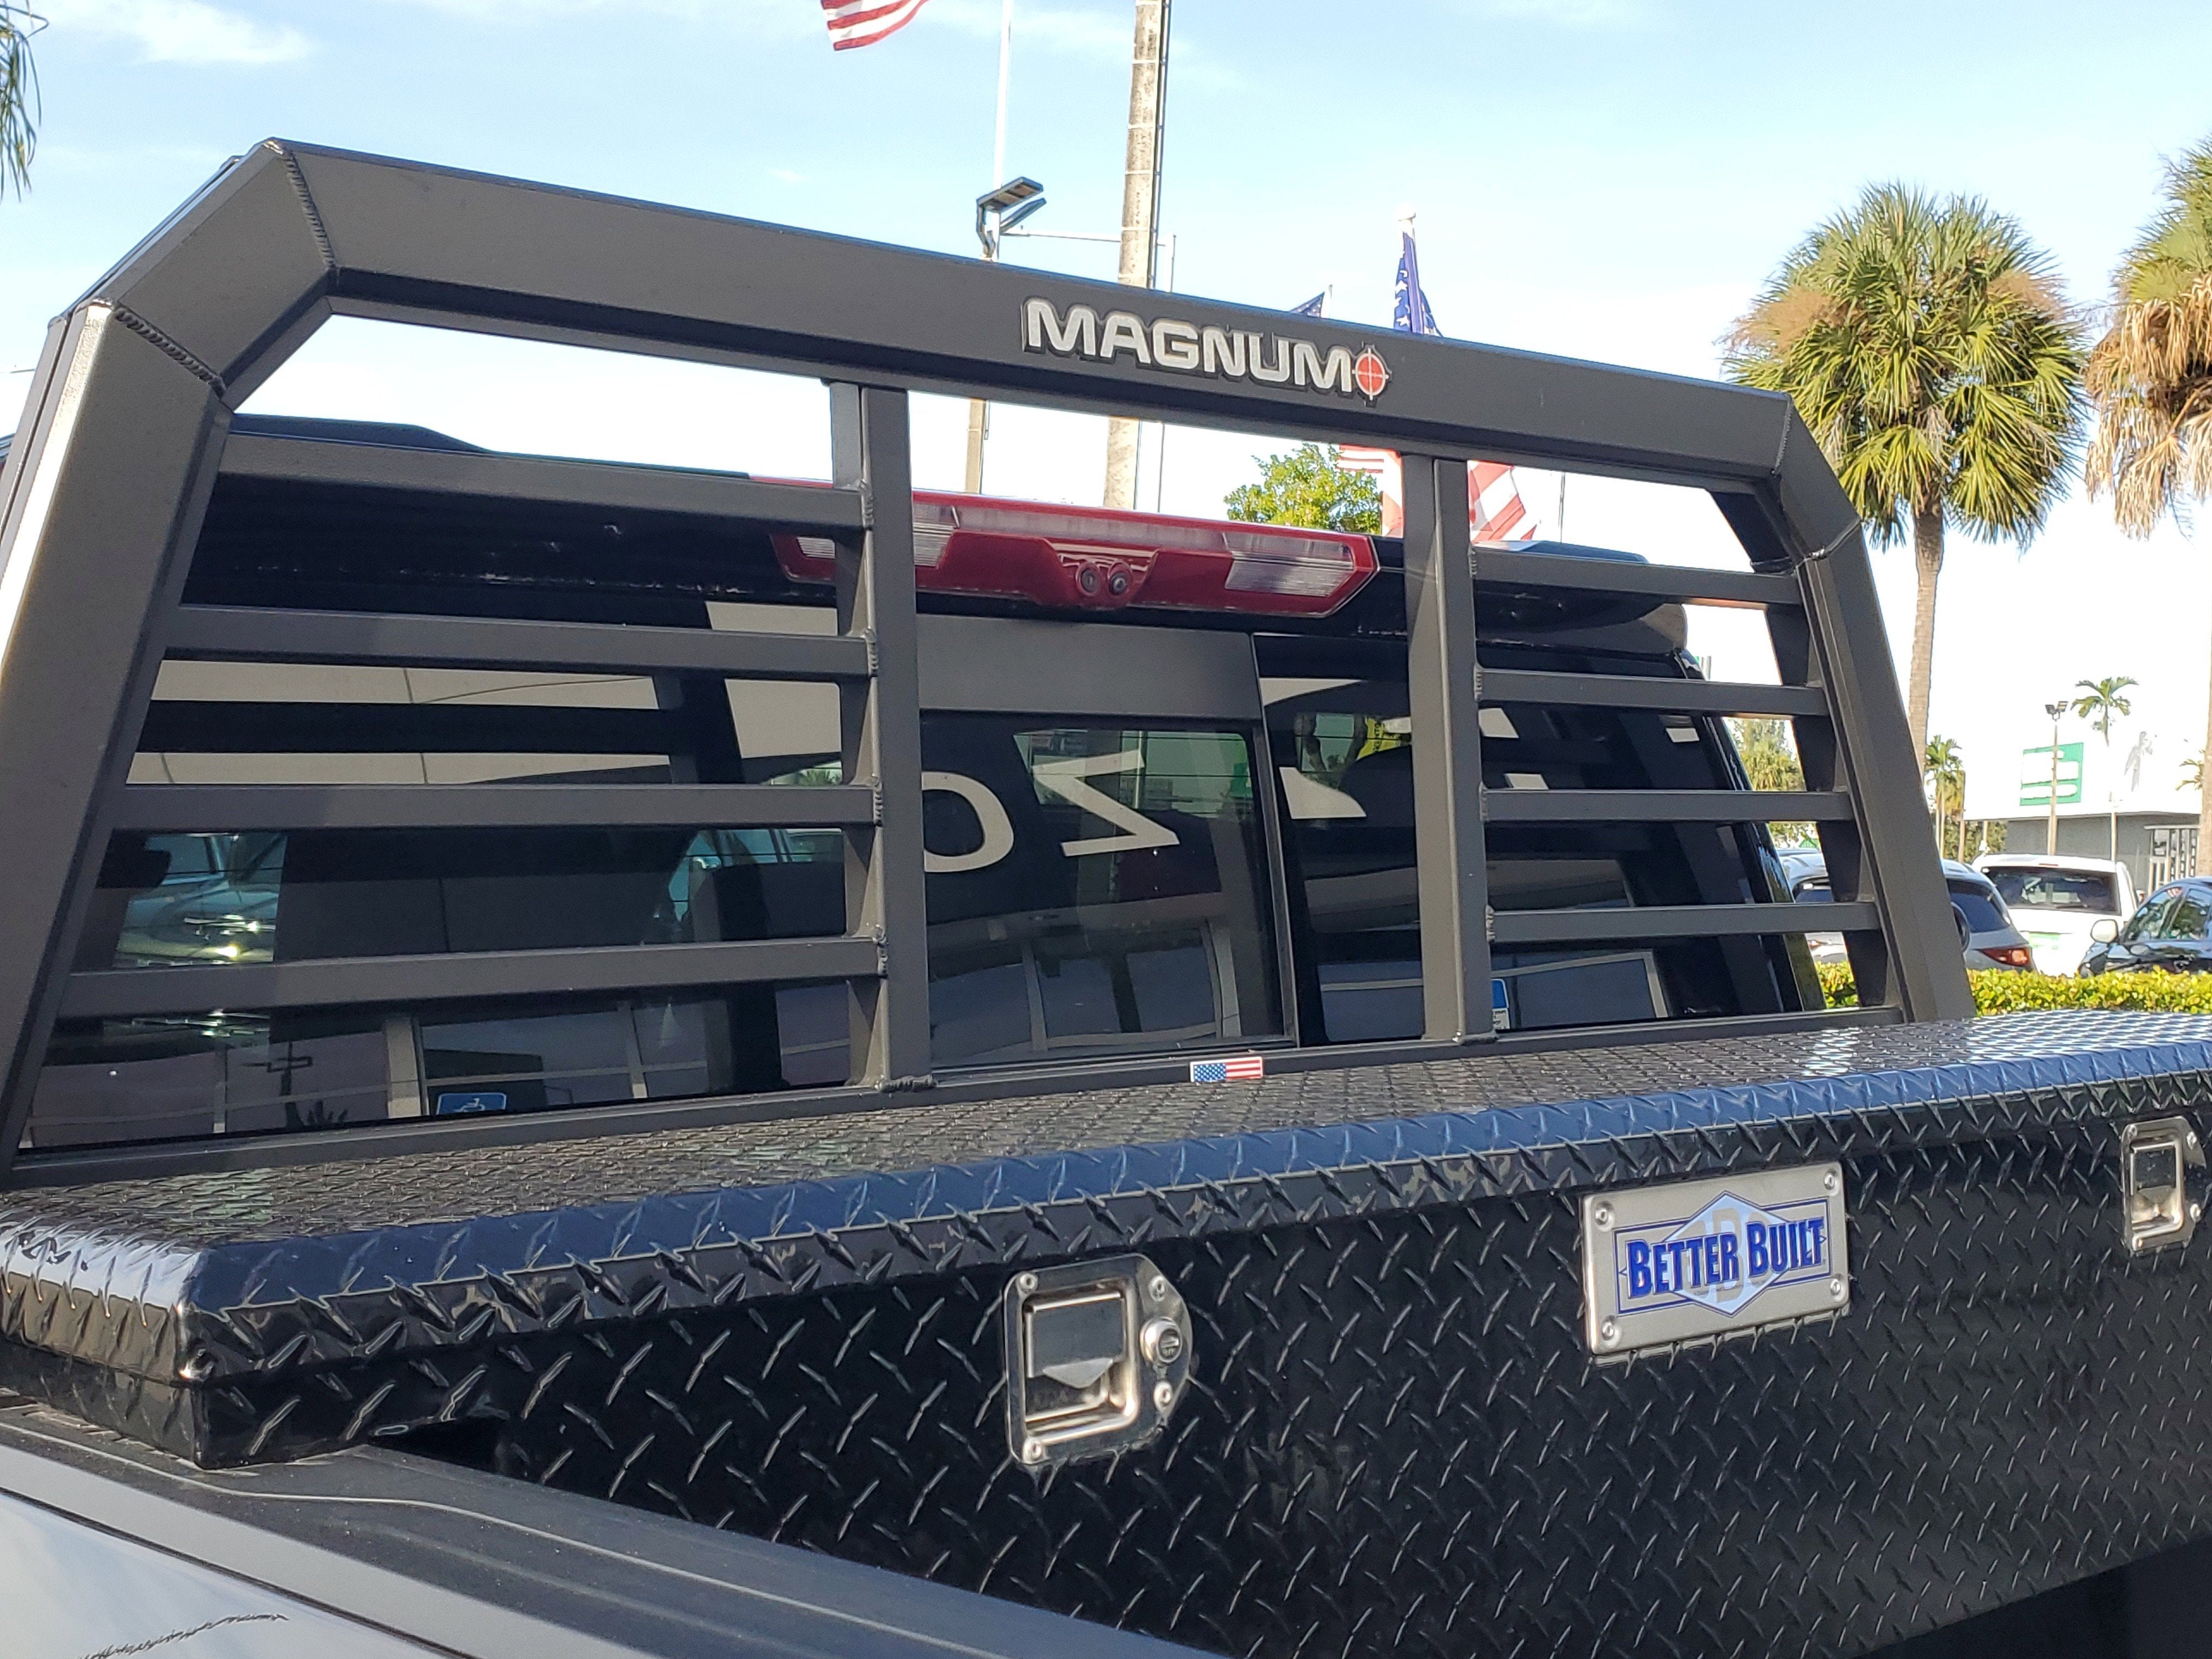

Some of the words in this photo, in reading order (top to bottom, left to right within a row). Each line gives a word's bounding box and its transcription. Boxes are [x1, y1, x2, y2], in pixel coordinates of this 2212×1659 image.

[1023, 297, 1353, 393] MAGNUM
[1625, 1232, 1739, 1299] BETTER
[1746, 1216, 1824, 1278] BUILT
